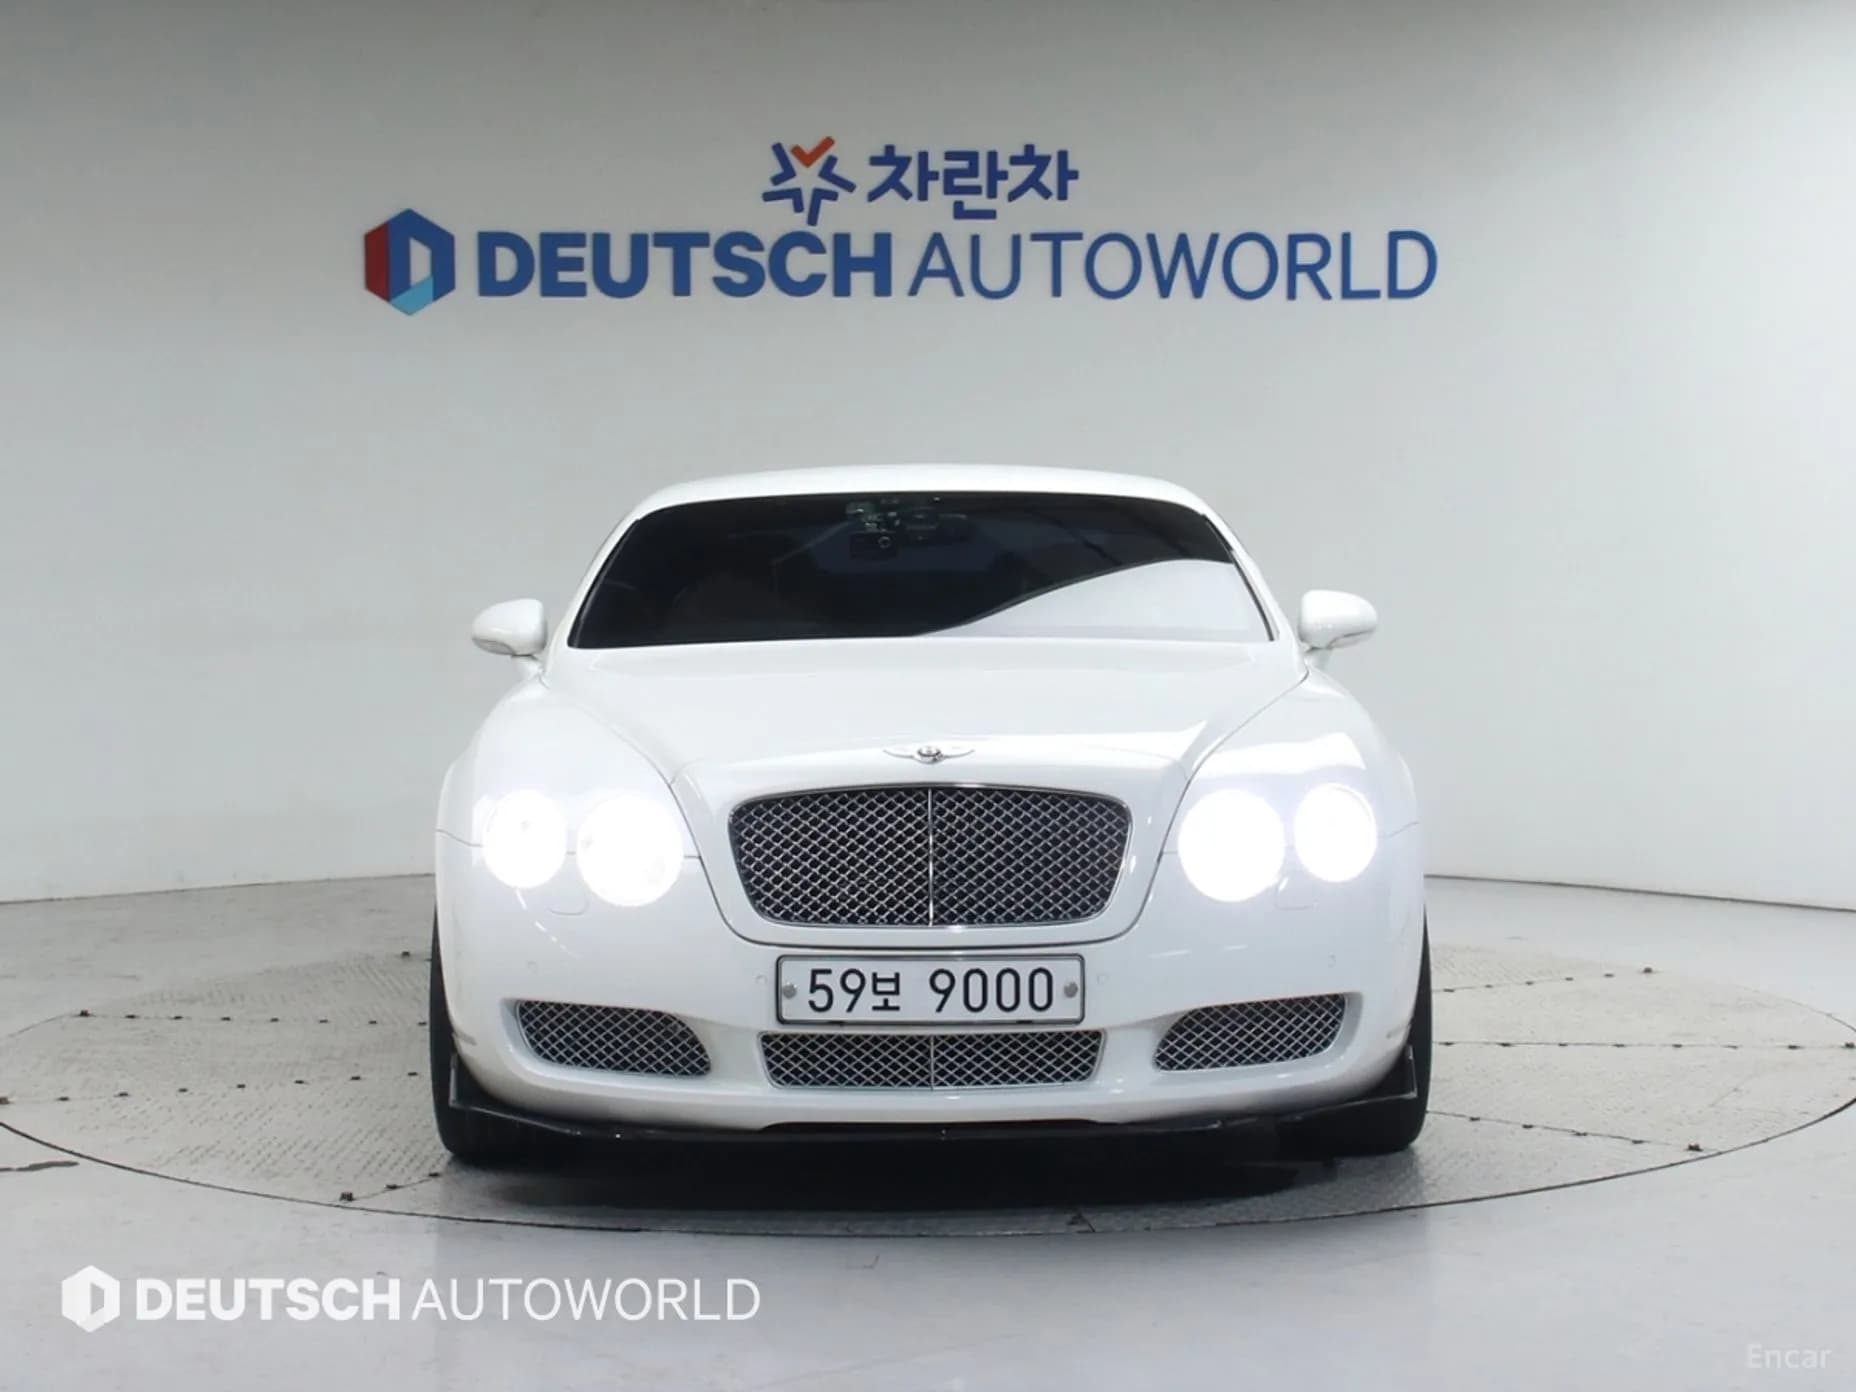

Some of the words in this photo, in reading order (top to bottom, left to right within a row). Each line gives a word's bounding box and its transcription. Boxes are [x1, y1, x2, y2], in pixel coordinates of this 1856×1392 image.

[867, 144, 1080, 220] 차란차
[476, 230, 893, 299] DEUTSCH
[907, 230, 1439, 301] AUTOWORLD
[808, 968, 901, 1013] 59보
[929, 967, 1054, 1013] 9000
